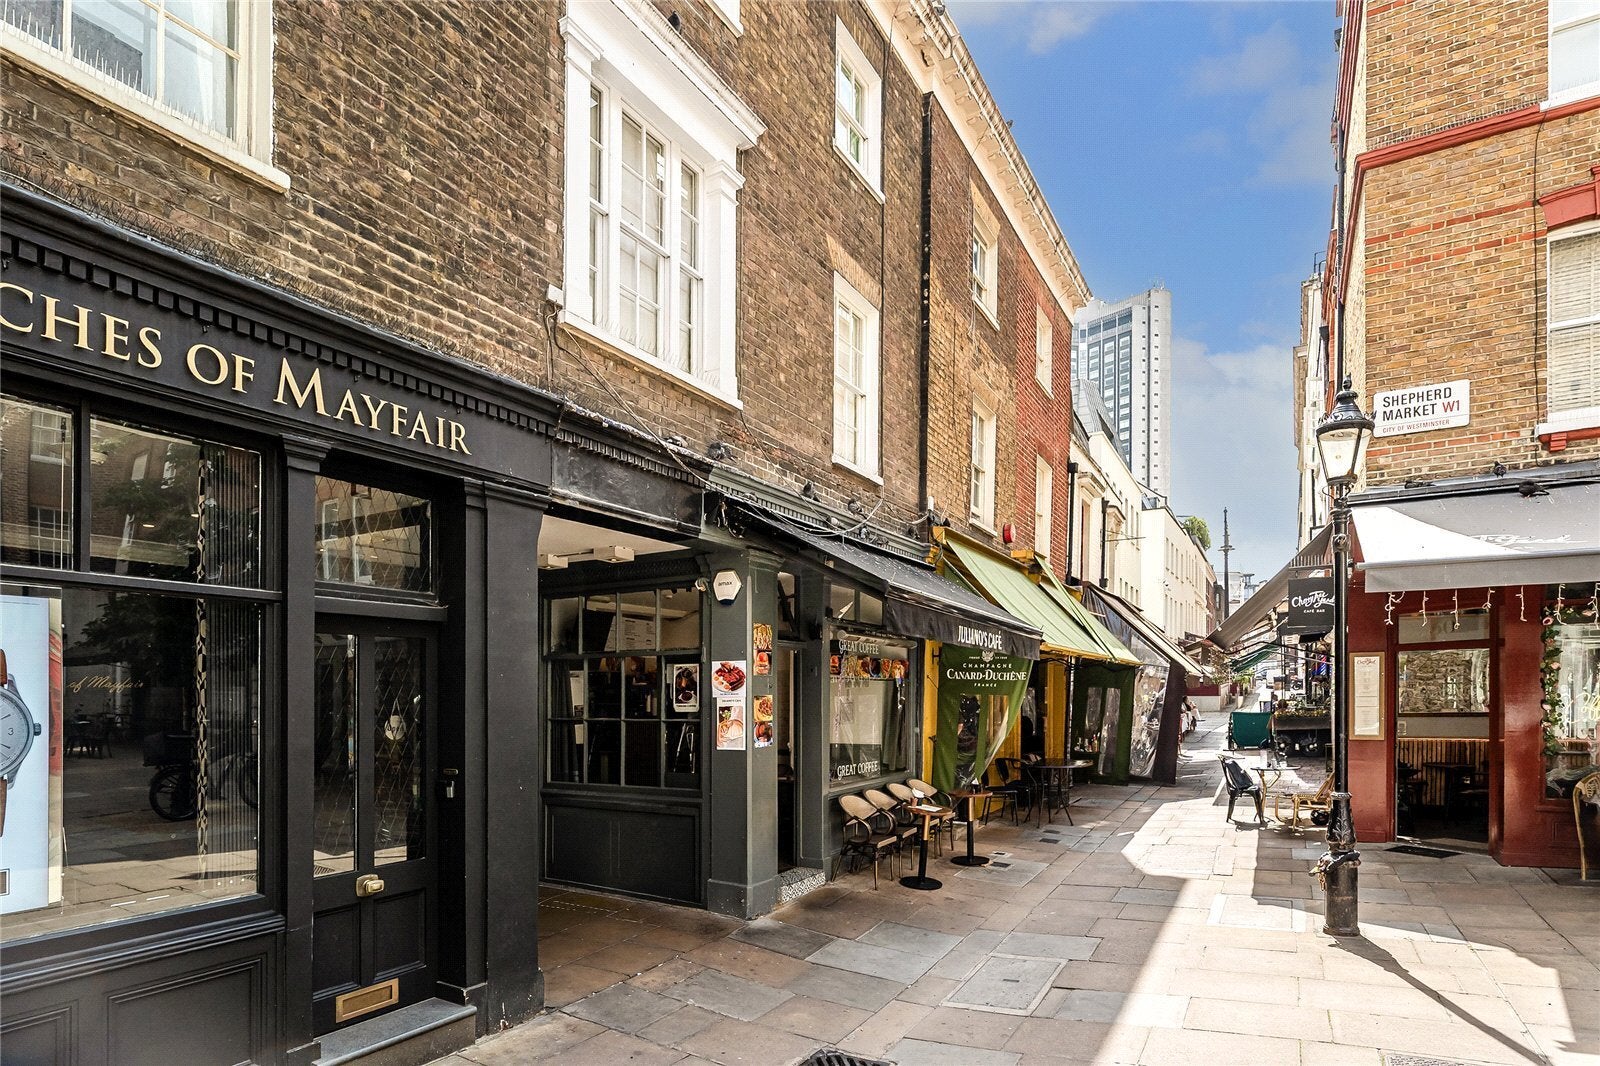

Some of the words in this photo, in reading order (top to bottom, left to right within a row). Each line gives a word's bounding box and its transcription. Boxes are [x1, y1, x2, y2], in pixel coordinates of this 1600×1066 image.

[186, 343, 255, 394] OF
[273, 357, 472, 455] MAYFAIR
[1382, 387, 1452, 408] SHEPHERD
[1382, 403, 1437, 421] MARKET
[1442, 400, 1460, 413] W1
[1382, 426, 1396, 434] CITY
[1397, 424, 1404, 432] OF
[1406, 419, 1450, 430] WESTMINSTER
[838, 640, 858, 654] GREAT
[858, 642, 879, 654] COFFEE
[957, 625, 988, 647] JULIANO'S
[987, 630, 1003, 650] CAFÉ
[67, 676, 88, 693] of
[86, 675, 144, 693] Mayfair
[7, 727, 15, 736] 3
[837, 763, 857, 779] GREAT
[857, 760, 878, 774] COFFEE
